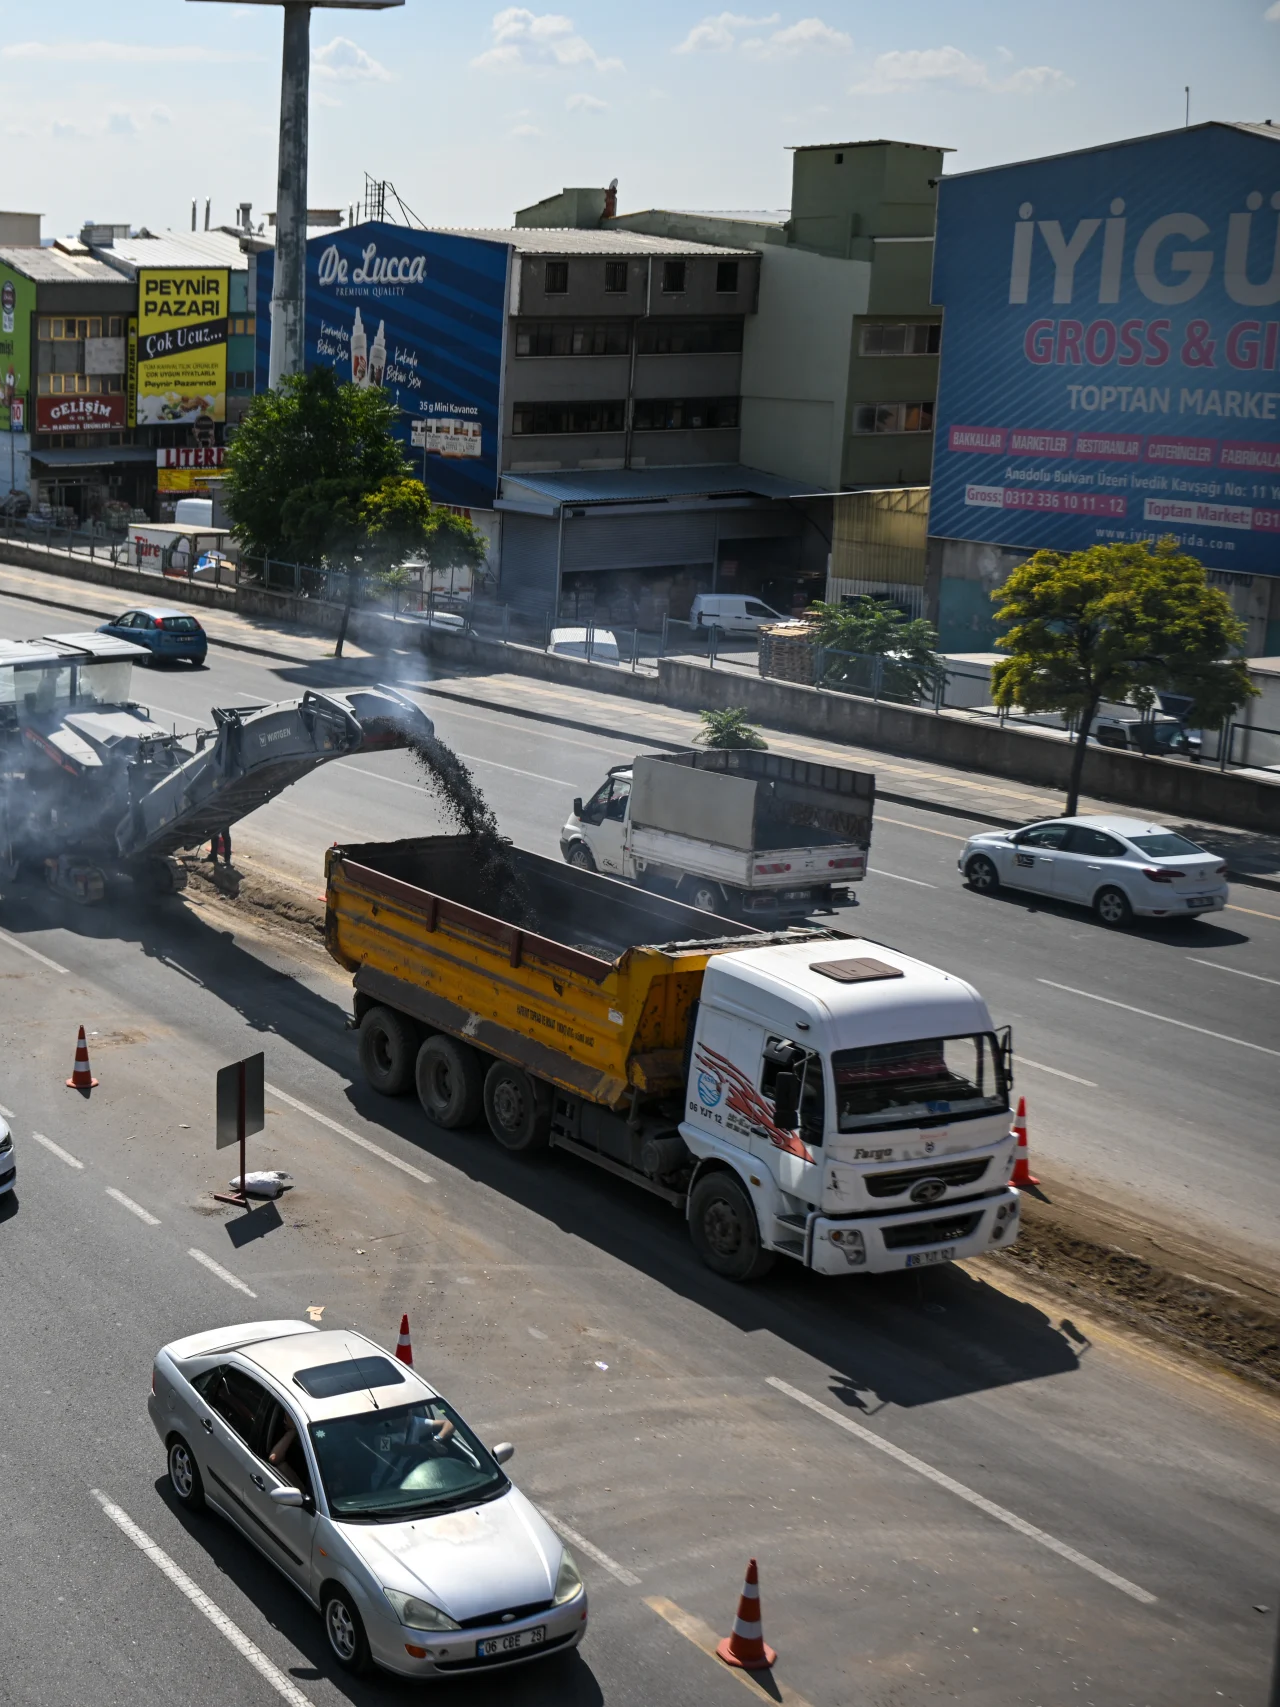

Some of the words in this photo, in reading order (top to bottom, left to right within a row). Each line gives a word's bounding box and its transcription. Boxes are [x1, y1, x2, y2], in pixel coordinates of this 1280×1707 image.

[1008, 190, 1280, 307] İYİGÜ
[318, 244, 348, 286] De
[353, 242, 426, 285] Lucca
[145, 275, 220, 296] PEYNİR
[336, 287, 369, 296] PREMIUM
[373, 286, 405, 298] QUALITY
[144, 300, 220, 317] PAZARI
[146, 332, 173, 359] Çok
[177, 327, 222, 347] Ucuz...
[1023, 318, 1172, 368] GROSS
[1179, 318, 1217, 369] &
[50, 398, 112, 420] GELİŞİM
[420, 401, 428, 411] 35
[429, 404, 434, 414] g
[434, 402, 449, 413] Mini
[449, 403, 478, 415] Kavanoz
[1067, 384, 1171, 414] TOPTAN
[953, 432, 1001, 448] BAKKALLAR
[1012, 434, 1068, 452] MARKETLER
[1076, 438, 1139, 456] RESTORANLAR
[1148, 442, 1211, 462] CATERİNGLER
[1005, 466, 1050, 482] Anadolu
[1054, 469, 1094, 485] Bulvarı
[1097, 469, 1127, 487] Üzeri
[1131, 471, 1168, 490] İvedik
[1171, 477, 1221, 497] Kavşağı
[1225, 482, 1247, 497] No:
[1252, 484, 1266, 499] 11
[967, 488, 1003, 503] Gross:
[1006, 491, 1034, 505] 0312
[1037, 493, 1059, 508] 336
[1064, 496, 1078, 509] 10
[1082, 497, 1096, 511] 11
[1109, 498, 1124, 513] 12
[1147, 501, 1192, 520] Toptan
[1197, 504, 1250, 525] Market:
[267, 727, 291, 742] WIRTGEN
[689, 1101, 698, 1112] 06
[700, 1106, 713, 1119] YJT
[714, 1113, 723, 1124] 12
[854, 1148, 892, 1160] Fargo
[912, 1254, 920, 1265] 06
[485, 1641, 497, 1654] 06
[503, 1635, 521, 1650] CBE
